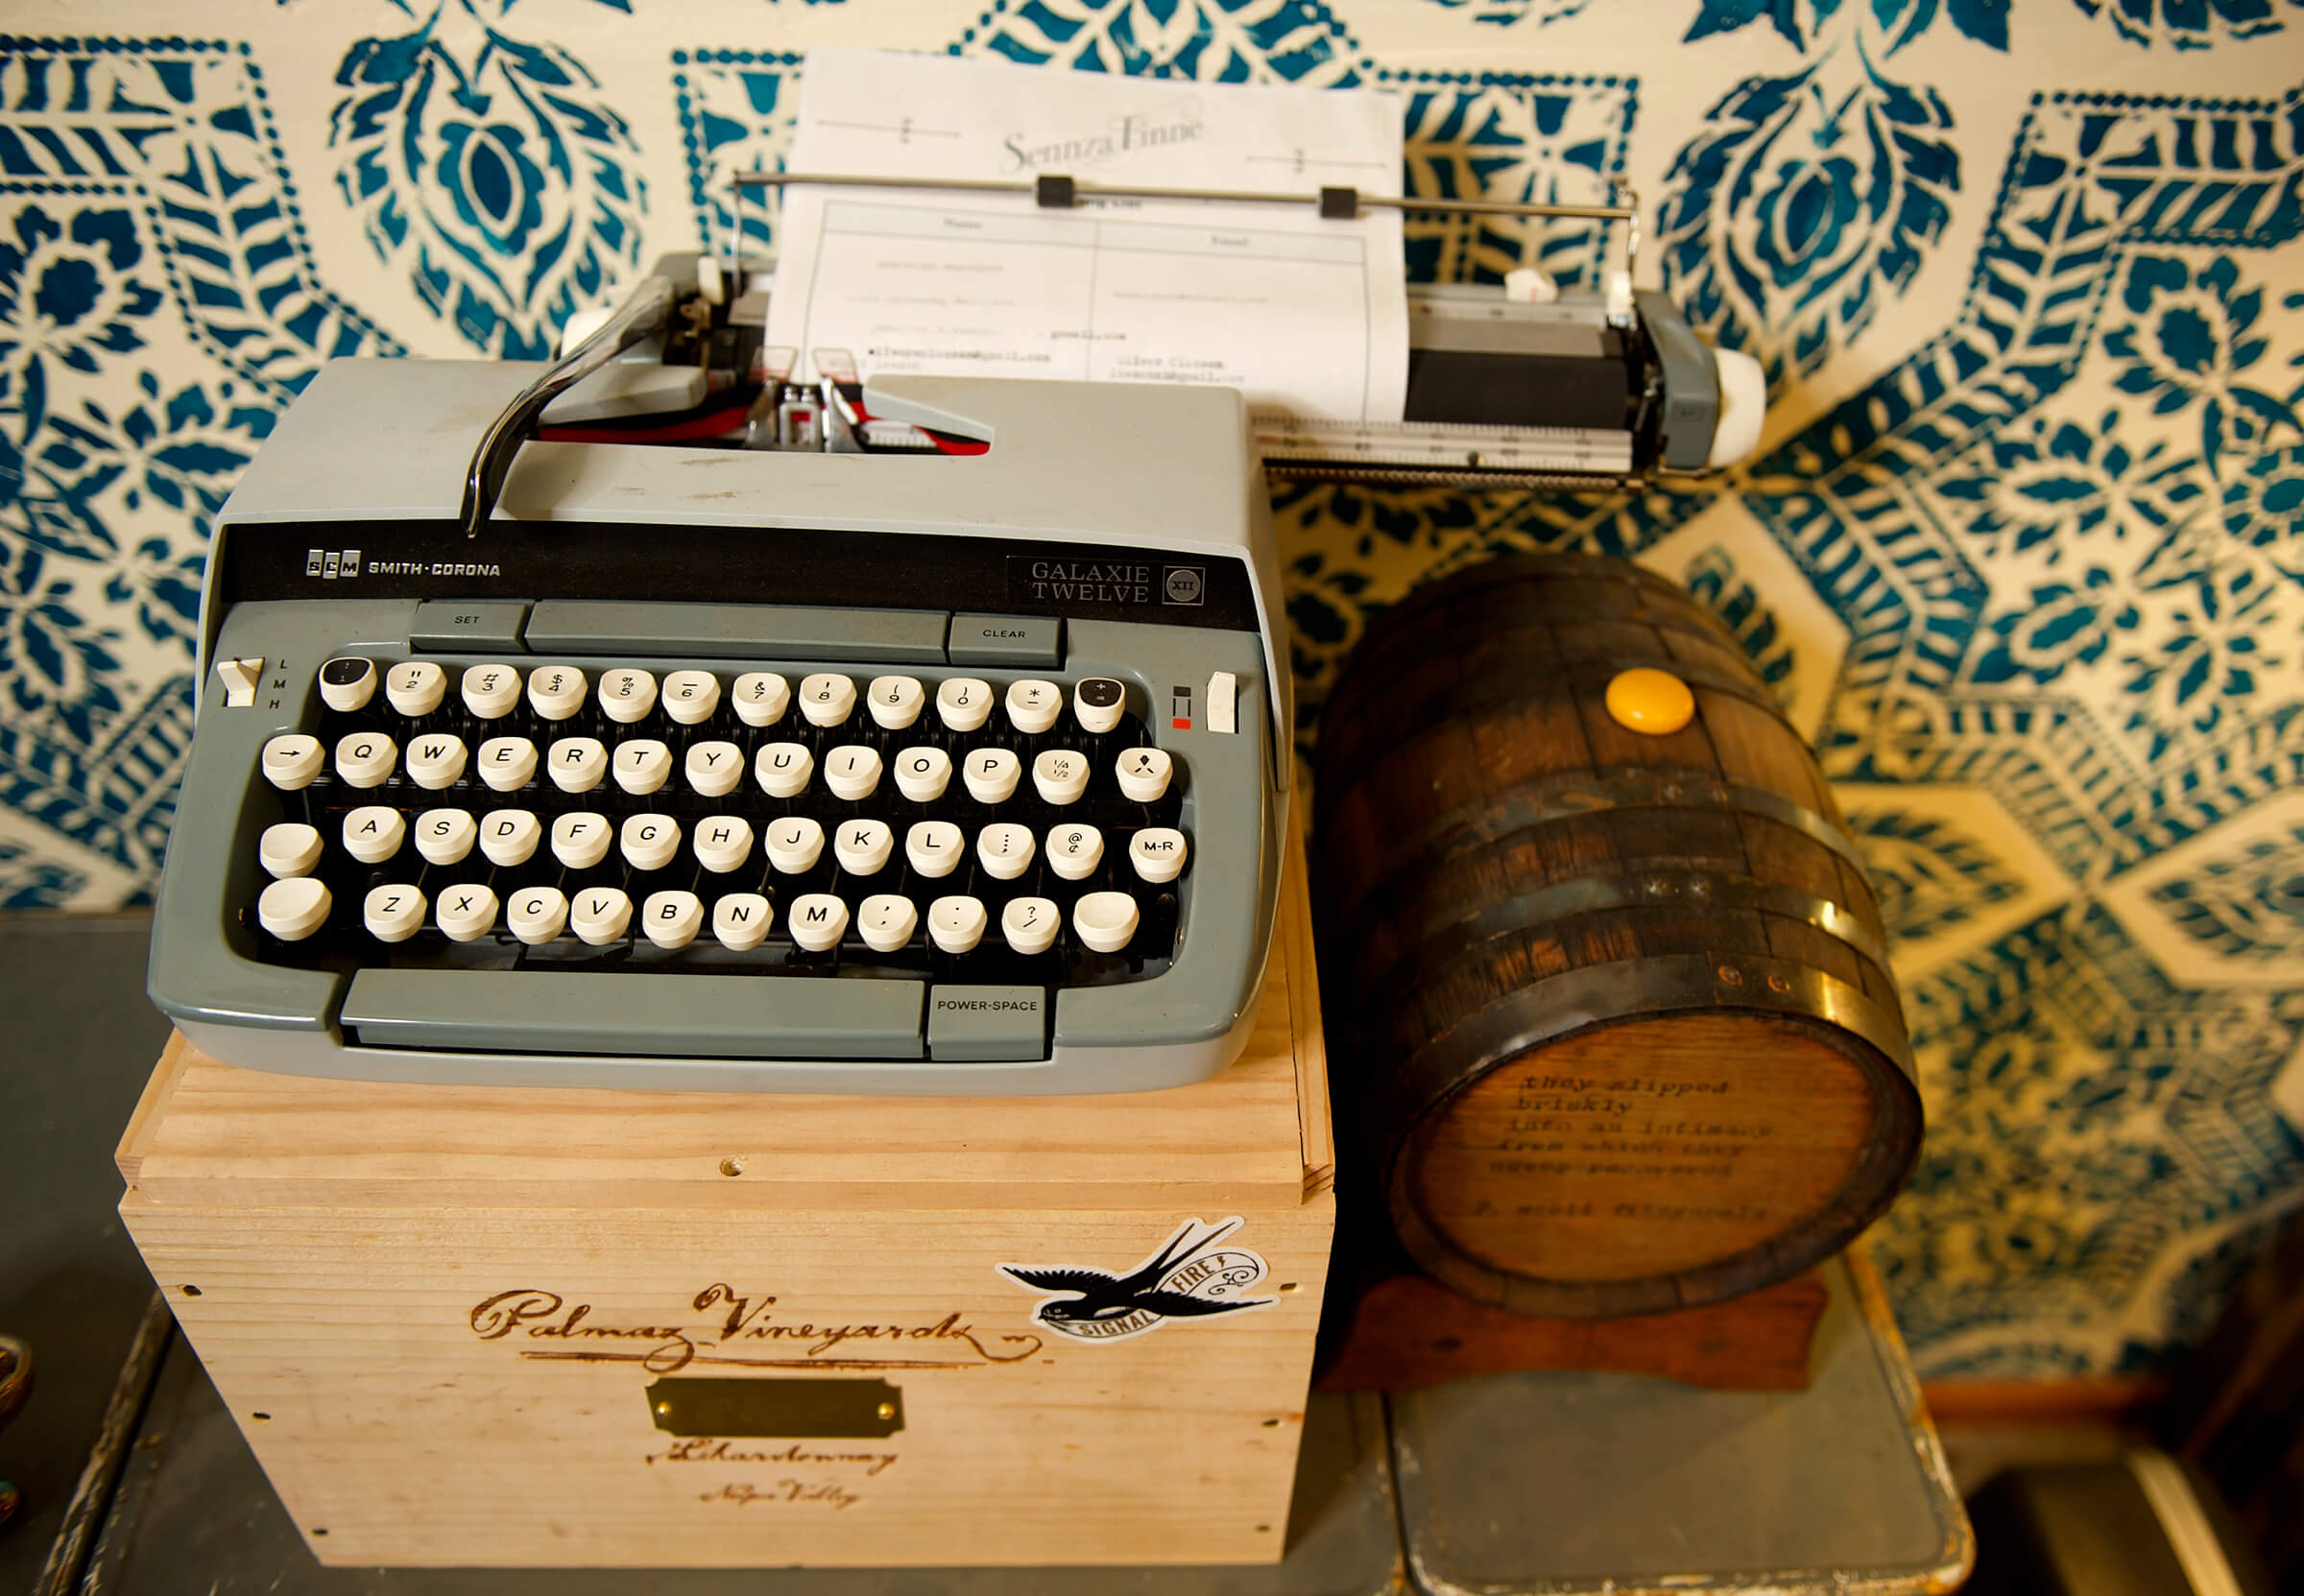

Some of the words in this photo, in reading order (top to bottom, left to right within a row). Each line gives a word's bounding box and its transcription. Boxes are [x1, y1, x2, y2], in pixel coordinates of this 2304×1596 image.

[1032, 562, 1149, 583] GALAXIE
[1032, 583, 1149, 603] TWELVE
[1172, 580, 1194, 591] XII
[454, 615, 480, 624] SET
[982, 629, 1026, 638] CLEAR
[279, 658, 288, 670] L
[273, 679, 287, 689] M
[269, 699, 280, 709] H
[354, 744, 372, 759] Q
[423, 745, 446, 759] W
[495, 748, 514, 762] E
[565, 749, 584, 763] R
[634, 750, 649, 765] T
[706, 752, 721, 767] Y
[774, 753, 791, 769] U
[848, 757, 855, 771] I
[913, 758, 930, 773] O
[983, 759, 998, 774] P
[360, 820, 377, 833] A
[433, 821, 451, 836] S
[496, 821, 516, 836] D
[569, 823, 588, 839] F
[639, 825, 658, 841] G
[711, 828, 731, 843] H
[785, 830, 802, 845] J
[853, 831, 871, 846] K
[925, 833, 941, 848] L
[1144, 841, 1173, 851] M-R
[382, 896, 401, 913] Z
[454, 896, 473, 912] X
[526, 899, 543, 915] C
[592, 899, 610, 916] V
[660, 904, 678, 919] B
[731, 906, 750, 922] N
[806, 906, 828, 922] M
[1172, 1260, 1216, 1294] FIRE
[470, 1289, 706, 1372] Palmaz
[693, 1283, 1043, 1361] Vineyards
[1079, 1311, 1153, 1338] SIGNAL
